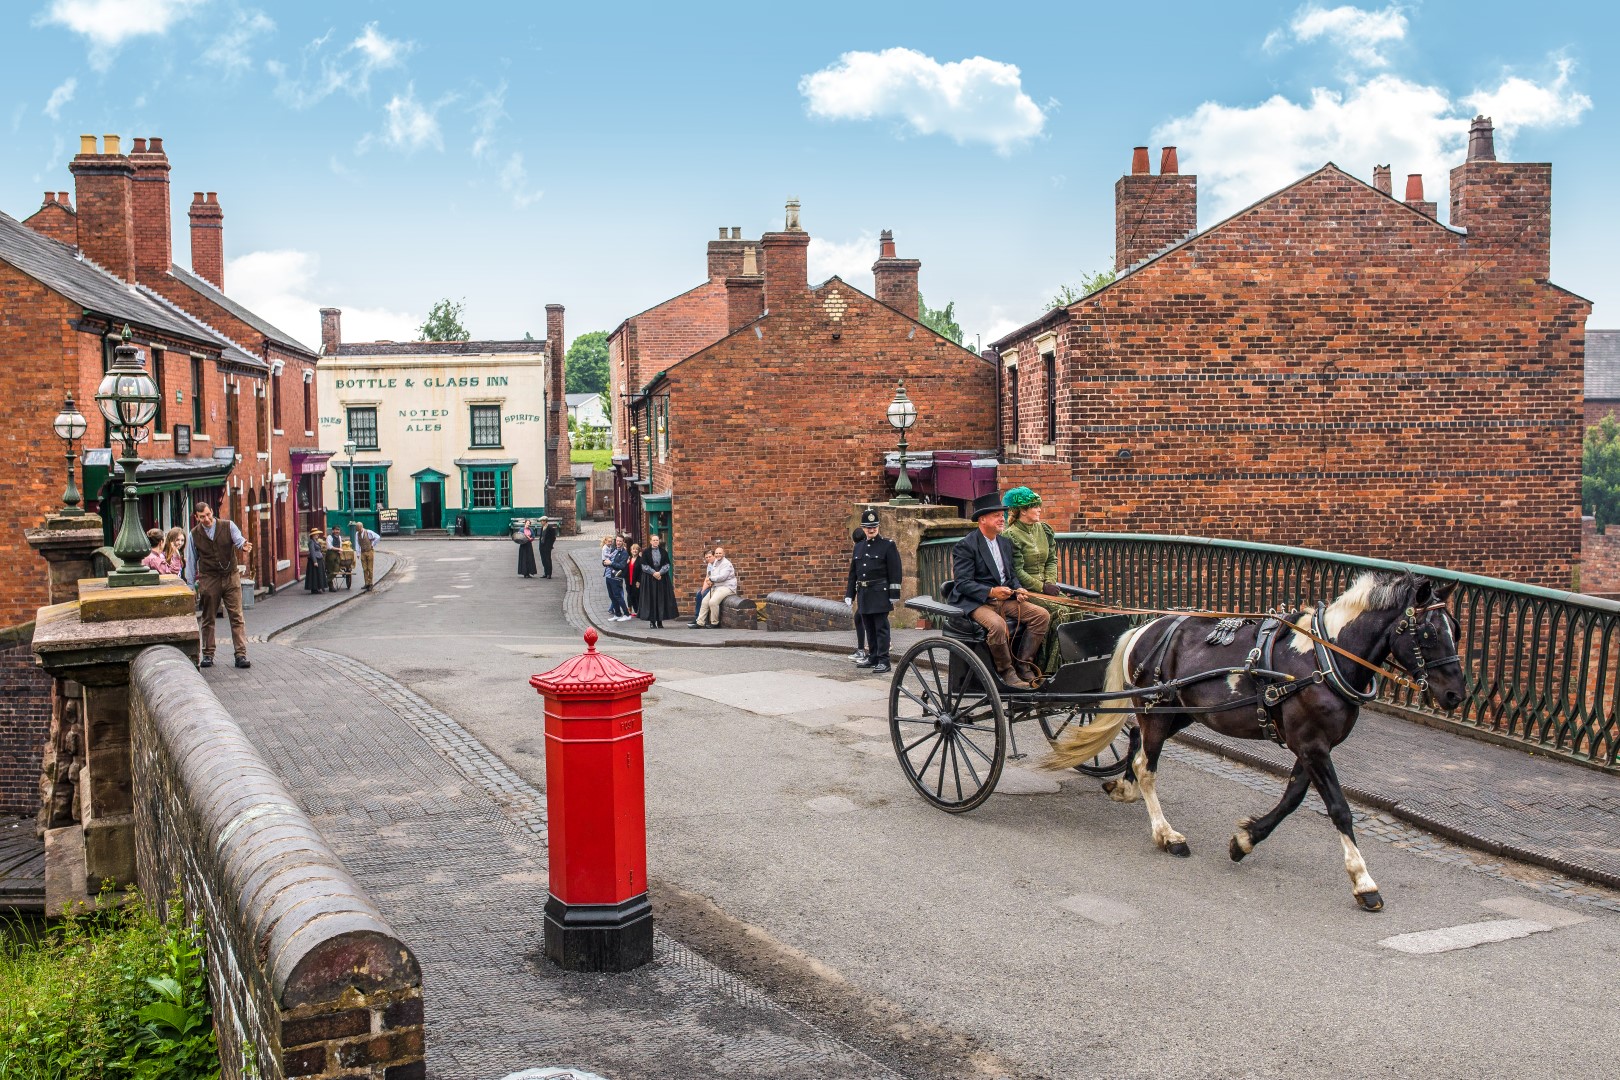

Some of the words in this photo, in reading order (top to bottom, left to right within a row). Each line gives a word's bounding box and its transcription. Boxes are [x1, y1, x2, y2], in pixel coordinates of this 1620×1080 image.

[336, 378, 397, 389] BOTTLE
[405, 378, 415, 388] &
[424, 377, 480, 388] GLASS
[486, 376, 508, 387] INN
[398, 409, 449, 418] NOTED
[318, 416, 342, 424] INES
[504, 414, 540, 424] SPIRITS
[406, 424, 442, 432] ALES
